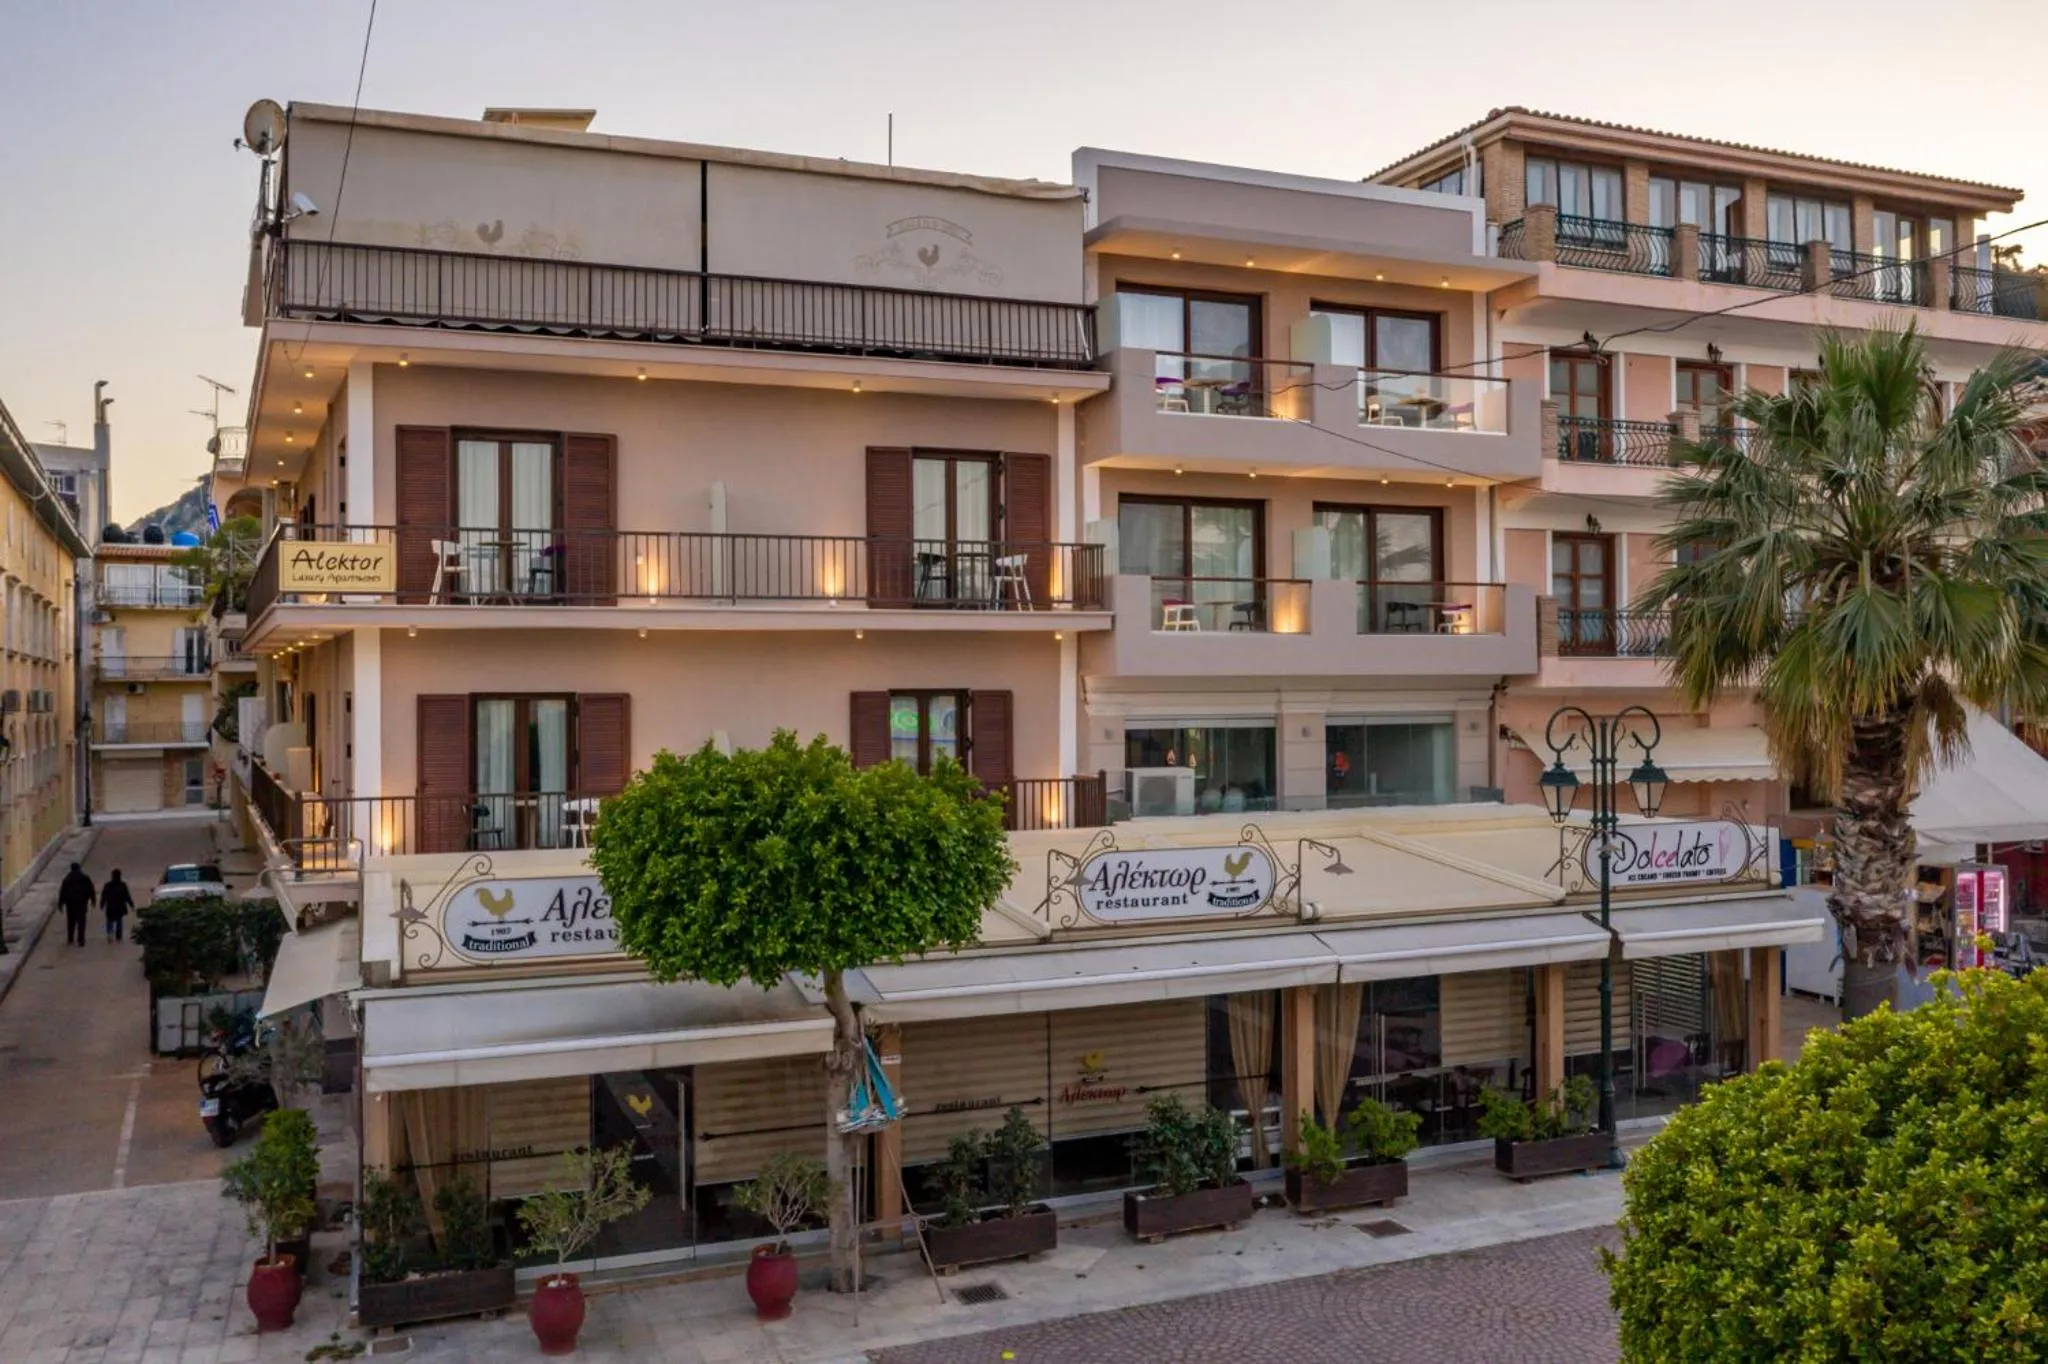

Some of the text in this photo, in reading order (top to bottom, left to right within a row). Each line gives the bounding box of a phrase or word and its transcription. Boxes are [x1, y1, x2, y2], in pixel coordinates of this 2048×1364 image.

[290, 549, 384, 571] Alektor
[1088, 860, 1207, 898] Αλέκτωρ
[1096, 893, 1189, 911] restaurant
[469, 934, 531, 951] traditional
[551, 927, 620, 943] restau
